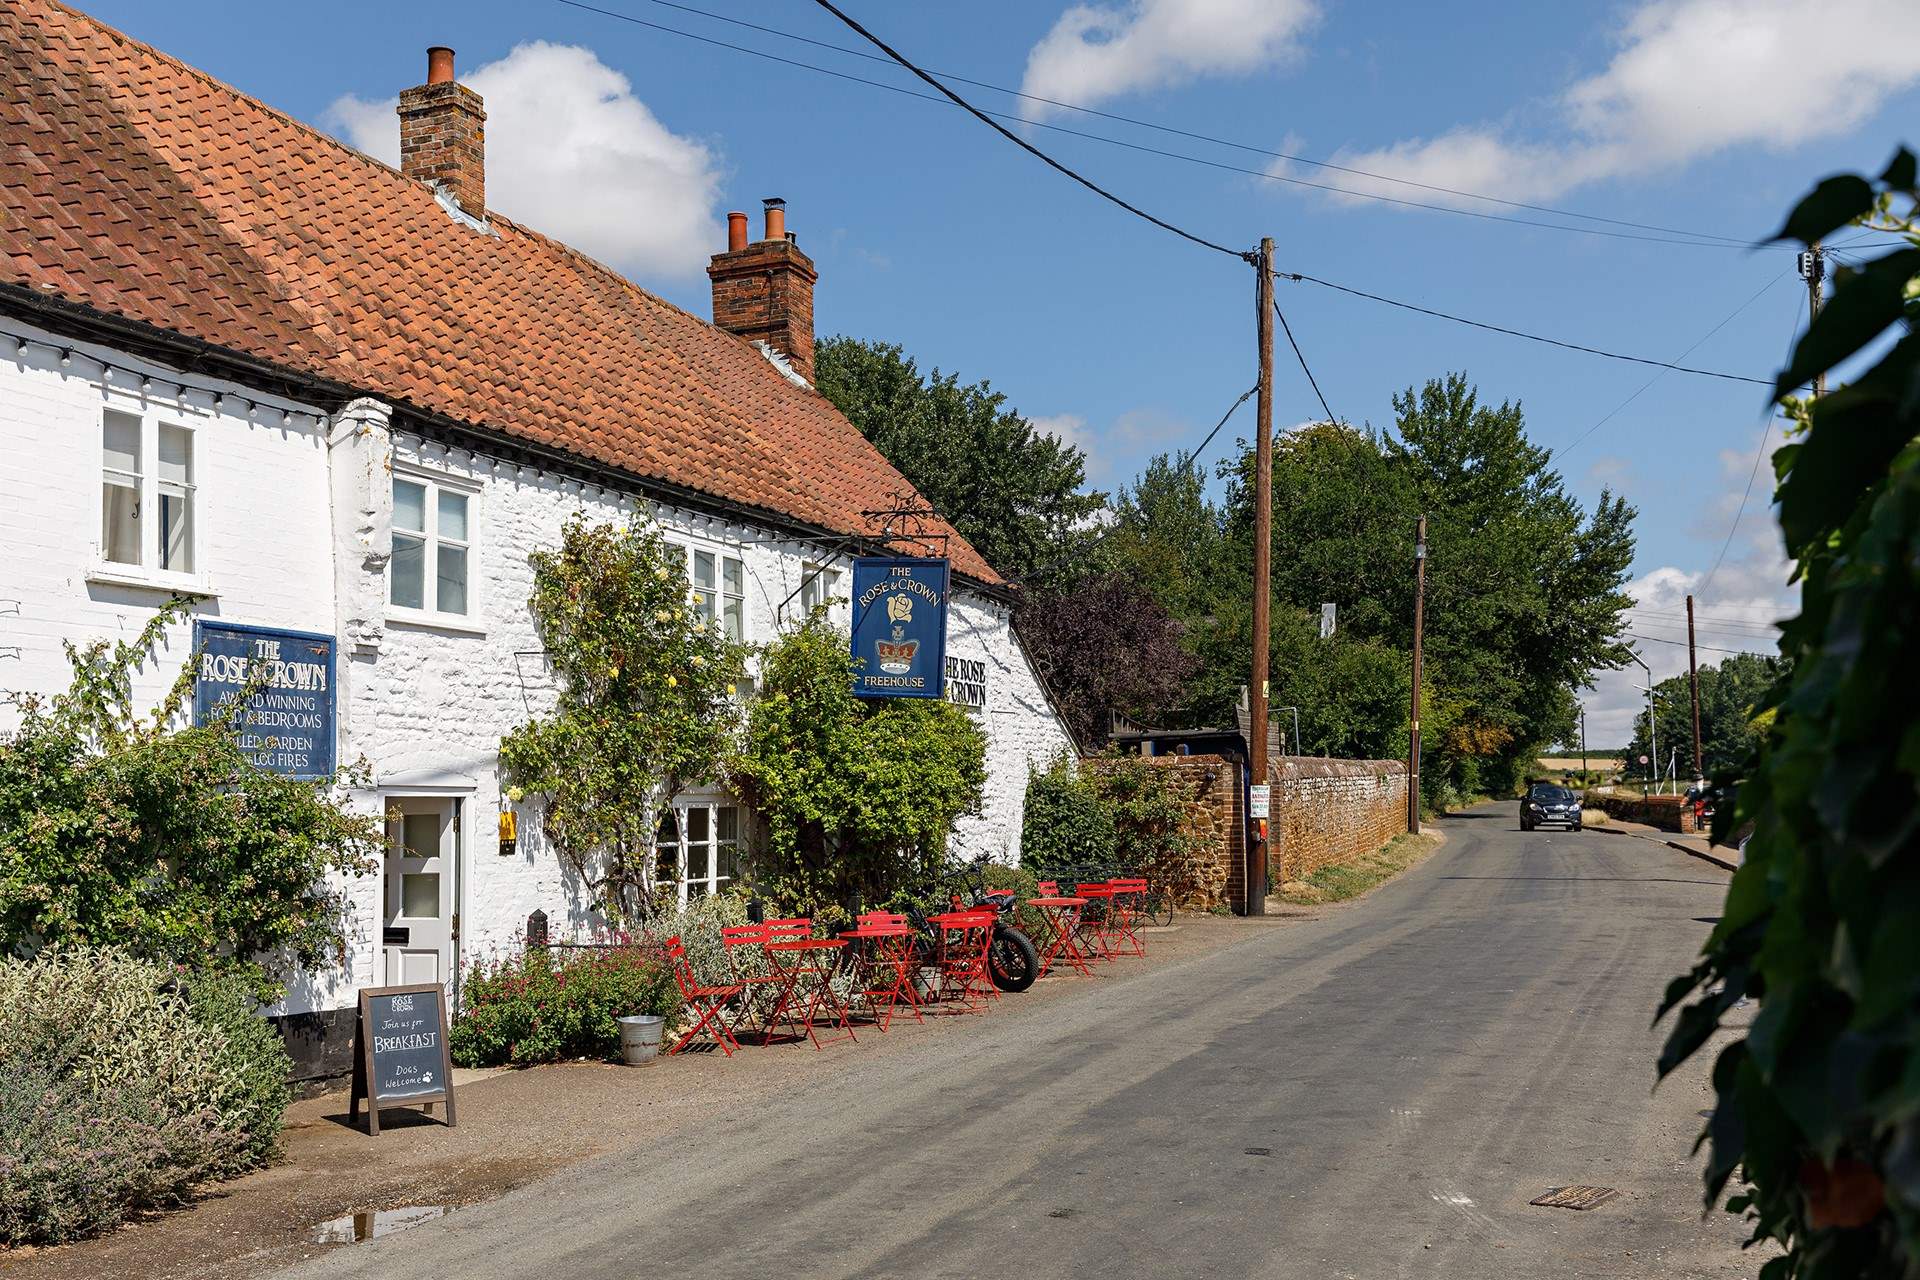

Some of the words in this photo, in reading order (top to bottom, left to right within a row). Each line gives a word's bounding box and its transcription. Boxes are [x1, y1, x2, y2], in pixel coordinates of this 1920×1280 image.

[890, 567, 912, 576] THE
[858, 580, 889, 608] ROSE
[890, 582, 898, 591] &
[898, 579, 941, 608] CROWN
[255, 639, 281, 660] THE
[201, 653, 249, 685] ROSE
[263, 659, 327, 692] CROWN
[945, 656, 959, 679] HE
[960, 658, 986, 684] ROSE
[864, 676, 925, 688] FREEHOUSE
[218, 690, 264, 708] AWRD
[266, 694, 315, 711] WINNING
[951, 680, 986, 706] CROWN
[211, 706, 242, 724] FOD
[258, 711, 322, 729] BEDROOMS
[278, 753, 309, 770] FIRES
[391, 995, 413, 1006] ROSE
[391, 1004, 414, 1012] CROWN
[381, 1018, 399, 1030] Join
[412, 1019, 424, 1030] for
[374, 1032, 436, 1053] BREAKFAST
